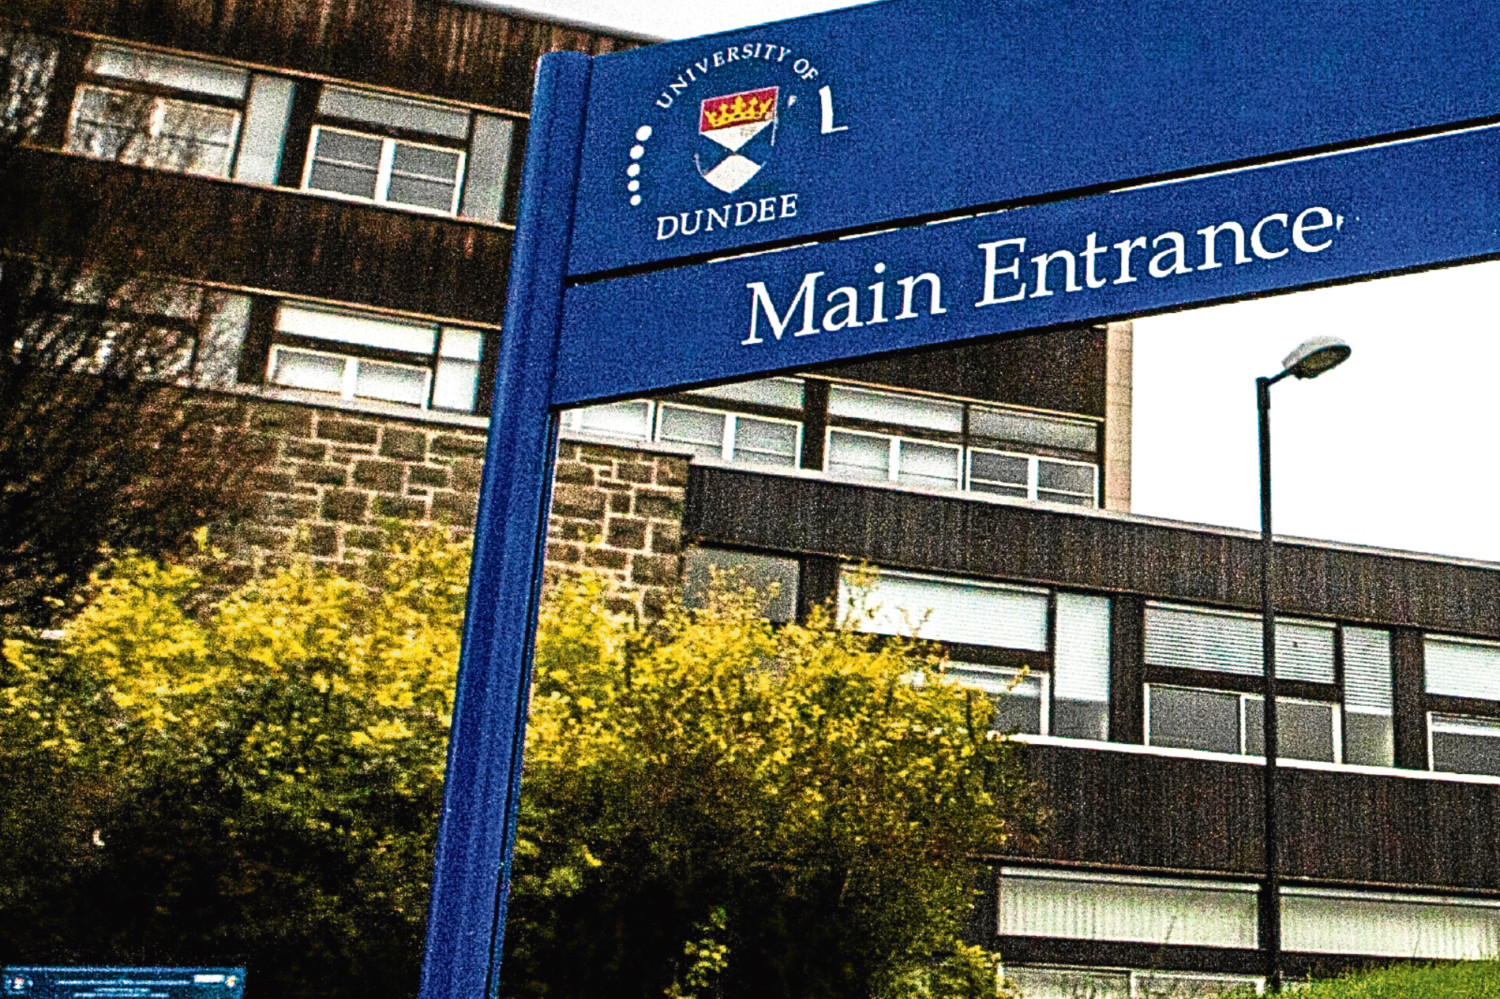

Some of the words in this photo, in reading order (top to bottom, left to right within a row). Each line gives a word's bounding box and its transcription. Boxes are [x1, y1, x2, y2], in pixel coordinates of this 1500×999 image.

[656, 43, 792, 109] UNIVERSITY
[793, 58, 819, 81] OF
[656, 193, 799, 241] DUNDEE
[741, 261, 947, 346] Main
[974, 206, 1333, 308] Entrance
